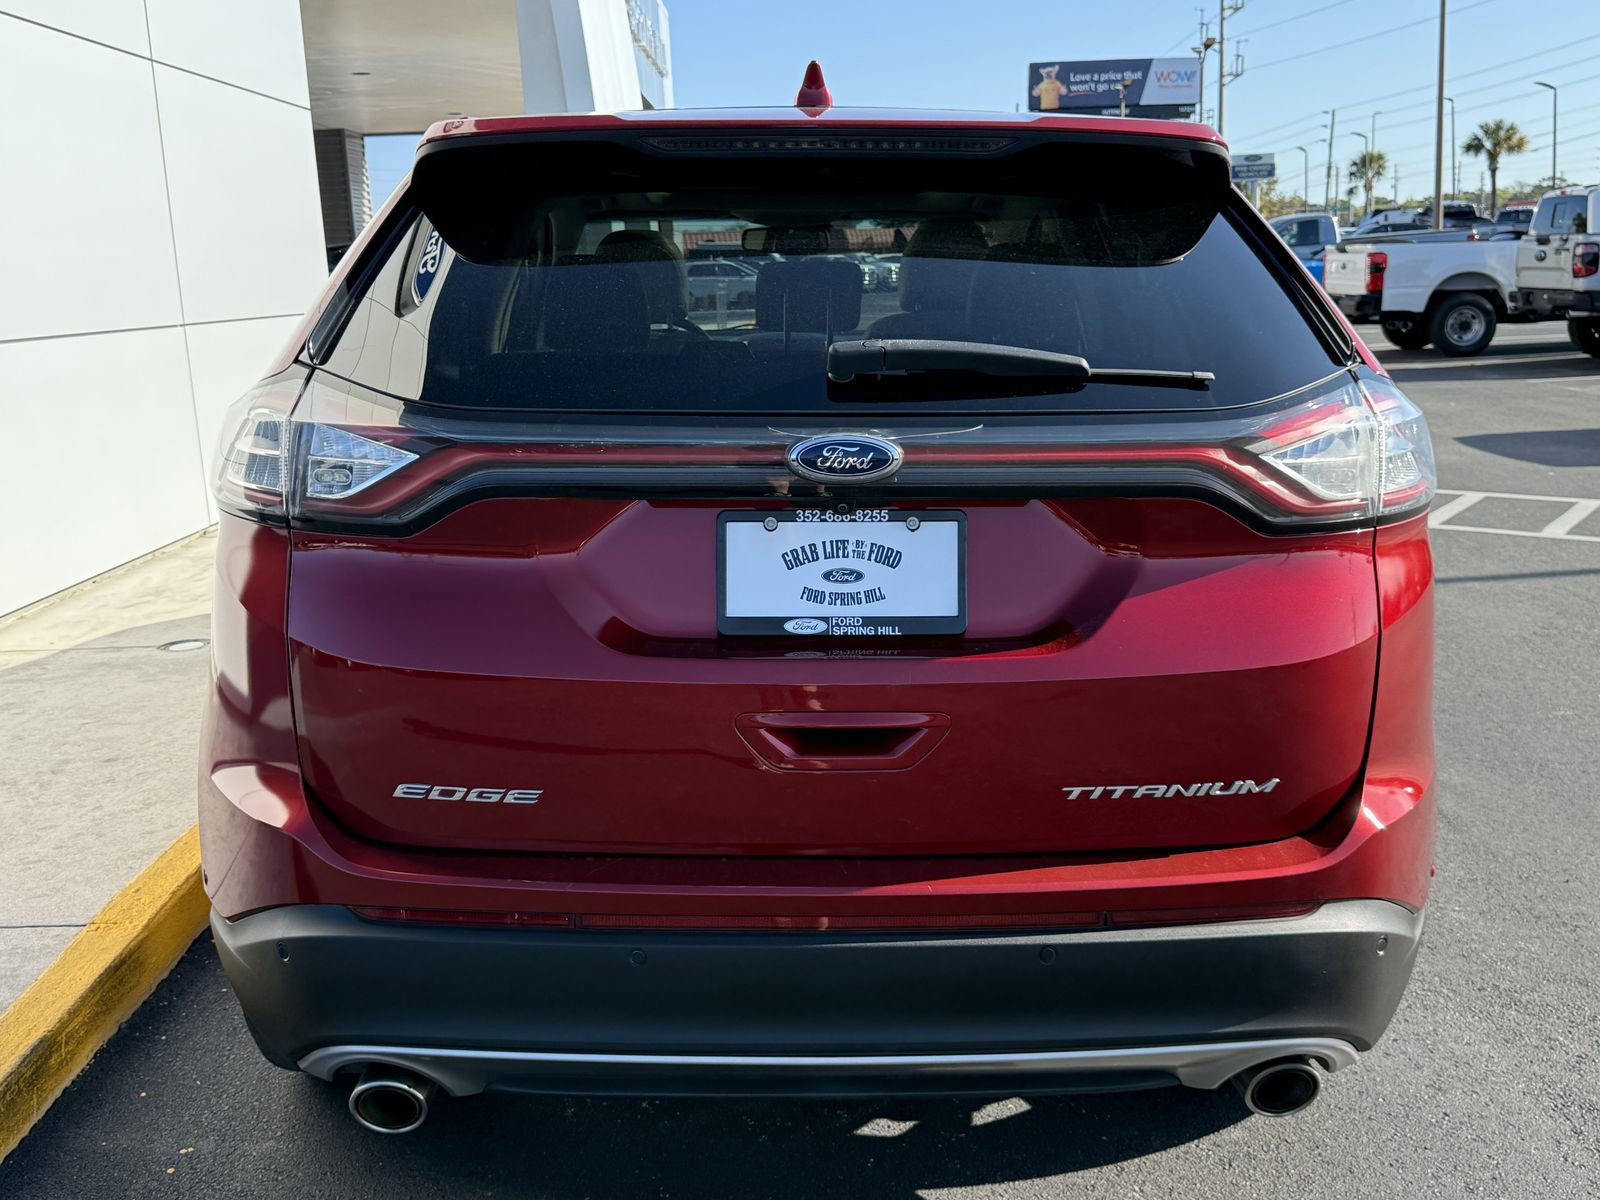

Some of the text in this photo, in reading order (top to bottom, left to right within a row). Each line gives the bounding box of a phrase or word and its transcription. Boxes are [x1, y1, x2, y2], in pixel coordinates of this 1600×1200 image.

[1069, 72, 1091, 82] Love
[1100, 71, 1123, 82] price
[1123, 70, 1143, 80] that
[1069, 82, 1095, 92] won't
[1096, 83, 1109, 93] go
[817, 445, 874, 469] Ford
[781, 539, 903, 571] GRAB LIFE BY THE FORD
[829, 569, 857, 581] Ford
[799, 586, 887, 607] FORD SPRING HILL
[792, 621, 819, 631] Ford
[832, 617, 862, 626] FORD
[832, 626, 902, 636] SPRING HILL
[392, 783, 544, 804] EDGE
[1061, 778, 1280, 800] TITANIUM
